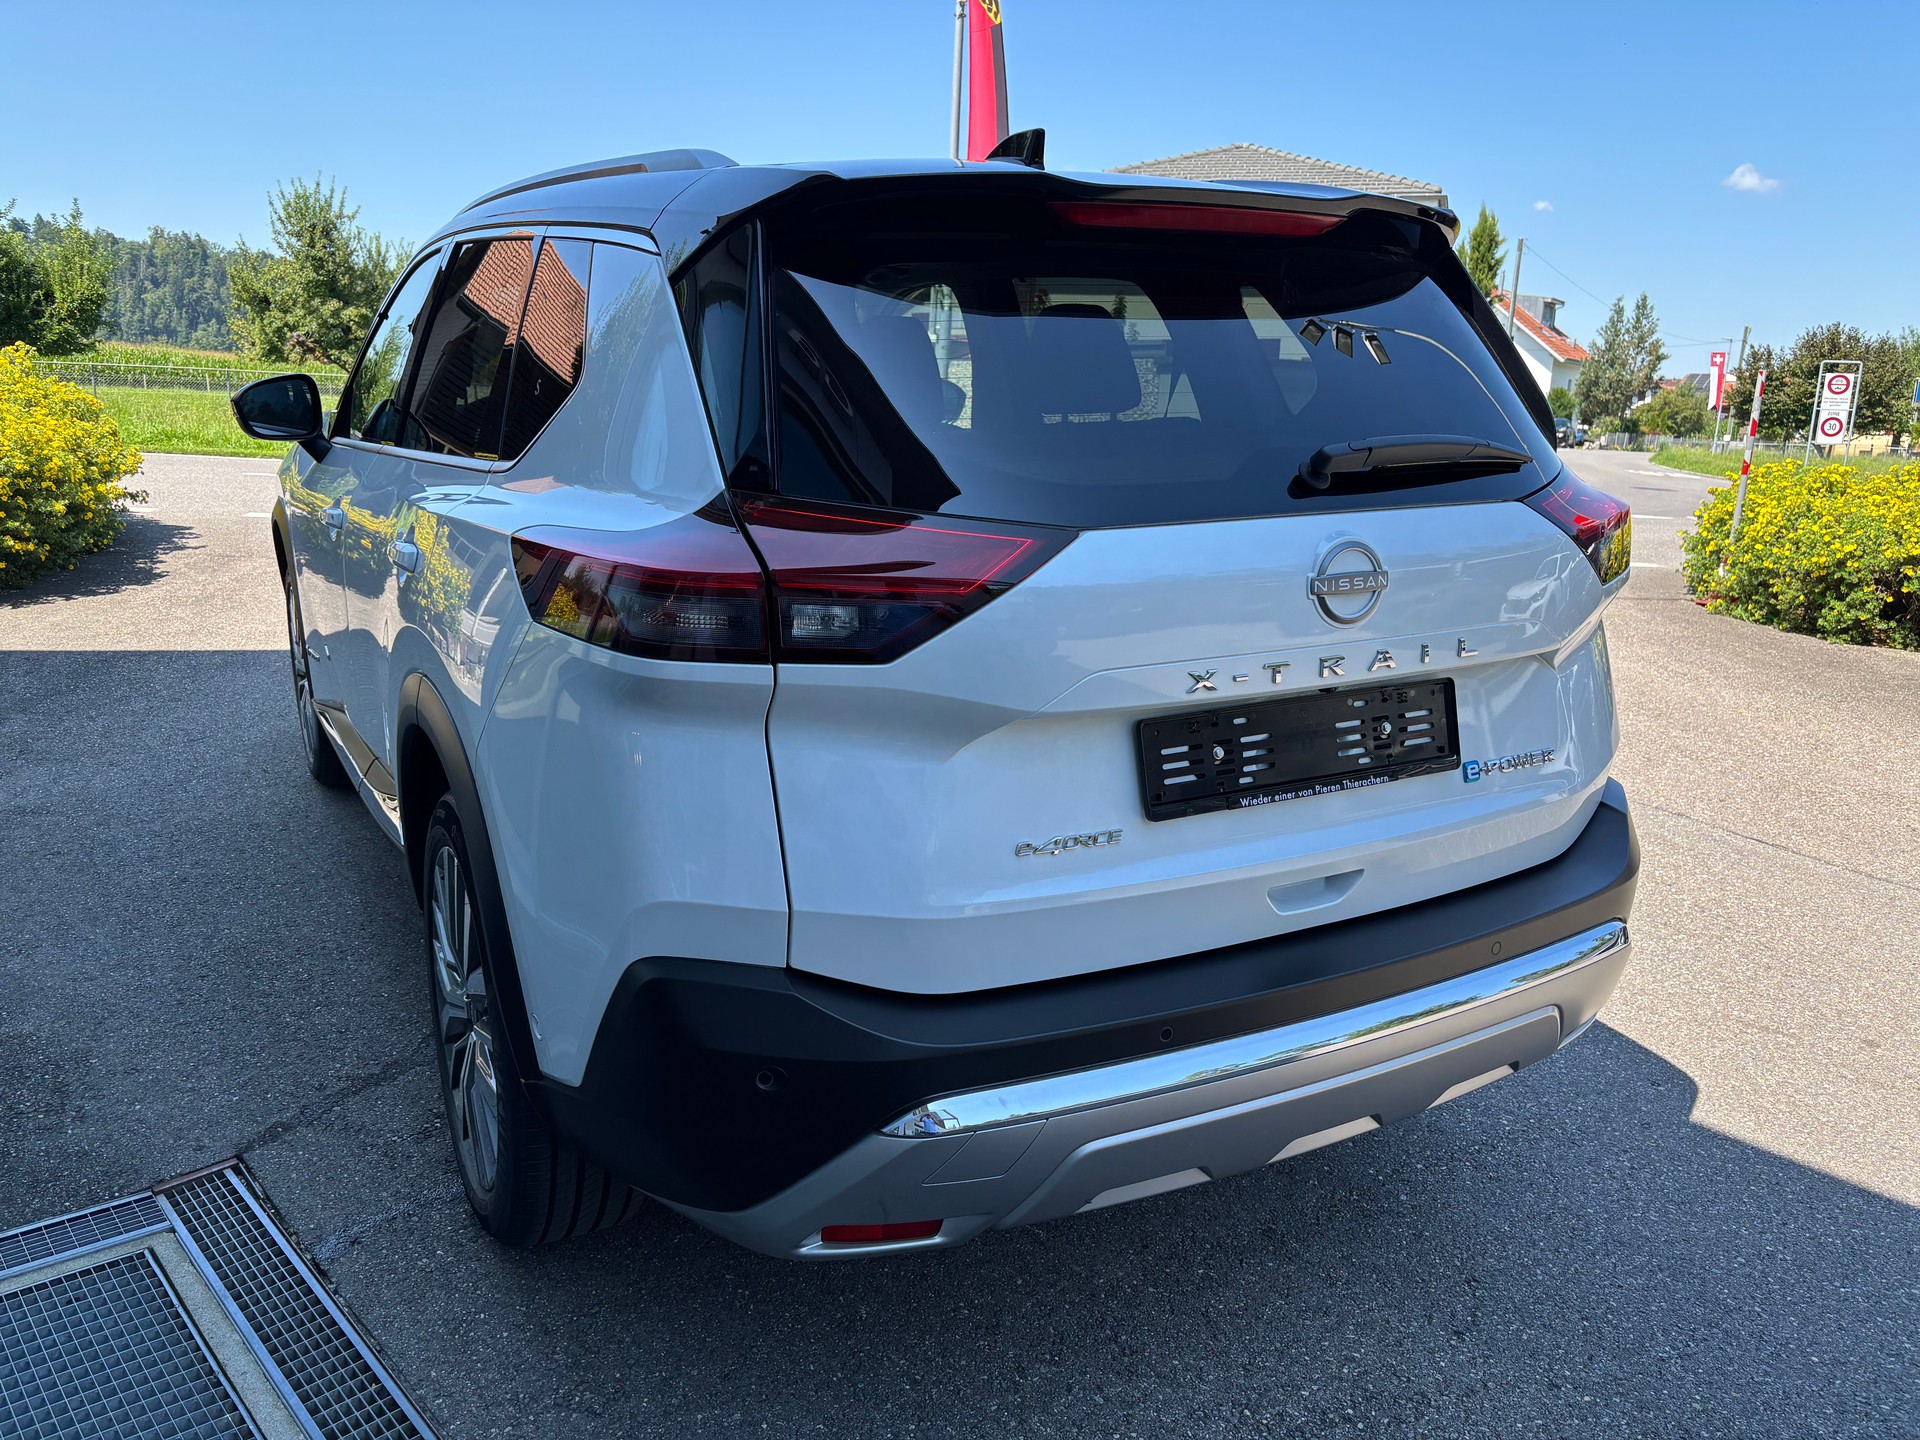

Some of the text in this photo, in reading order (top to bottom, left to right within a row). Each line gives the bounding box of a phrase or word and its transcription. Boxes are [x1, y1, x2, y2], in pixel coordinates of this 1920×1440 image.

[1827, 423, 1837, 431] 30
[1314, 573, 1388, 593] NISSAN
[1186, 637, 1479, 694] X-TRAIL
[1240, 774, 1389, 807] Wieder einer von Pieren Thierachern
